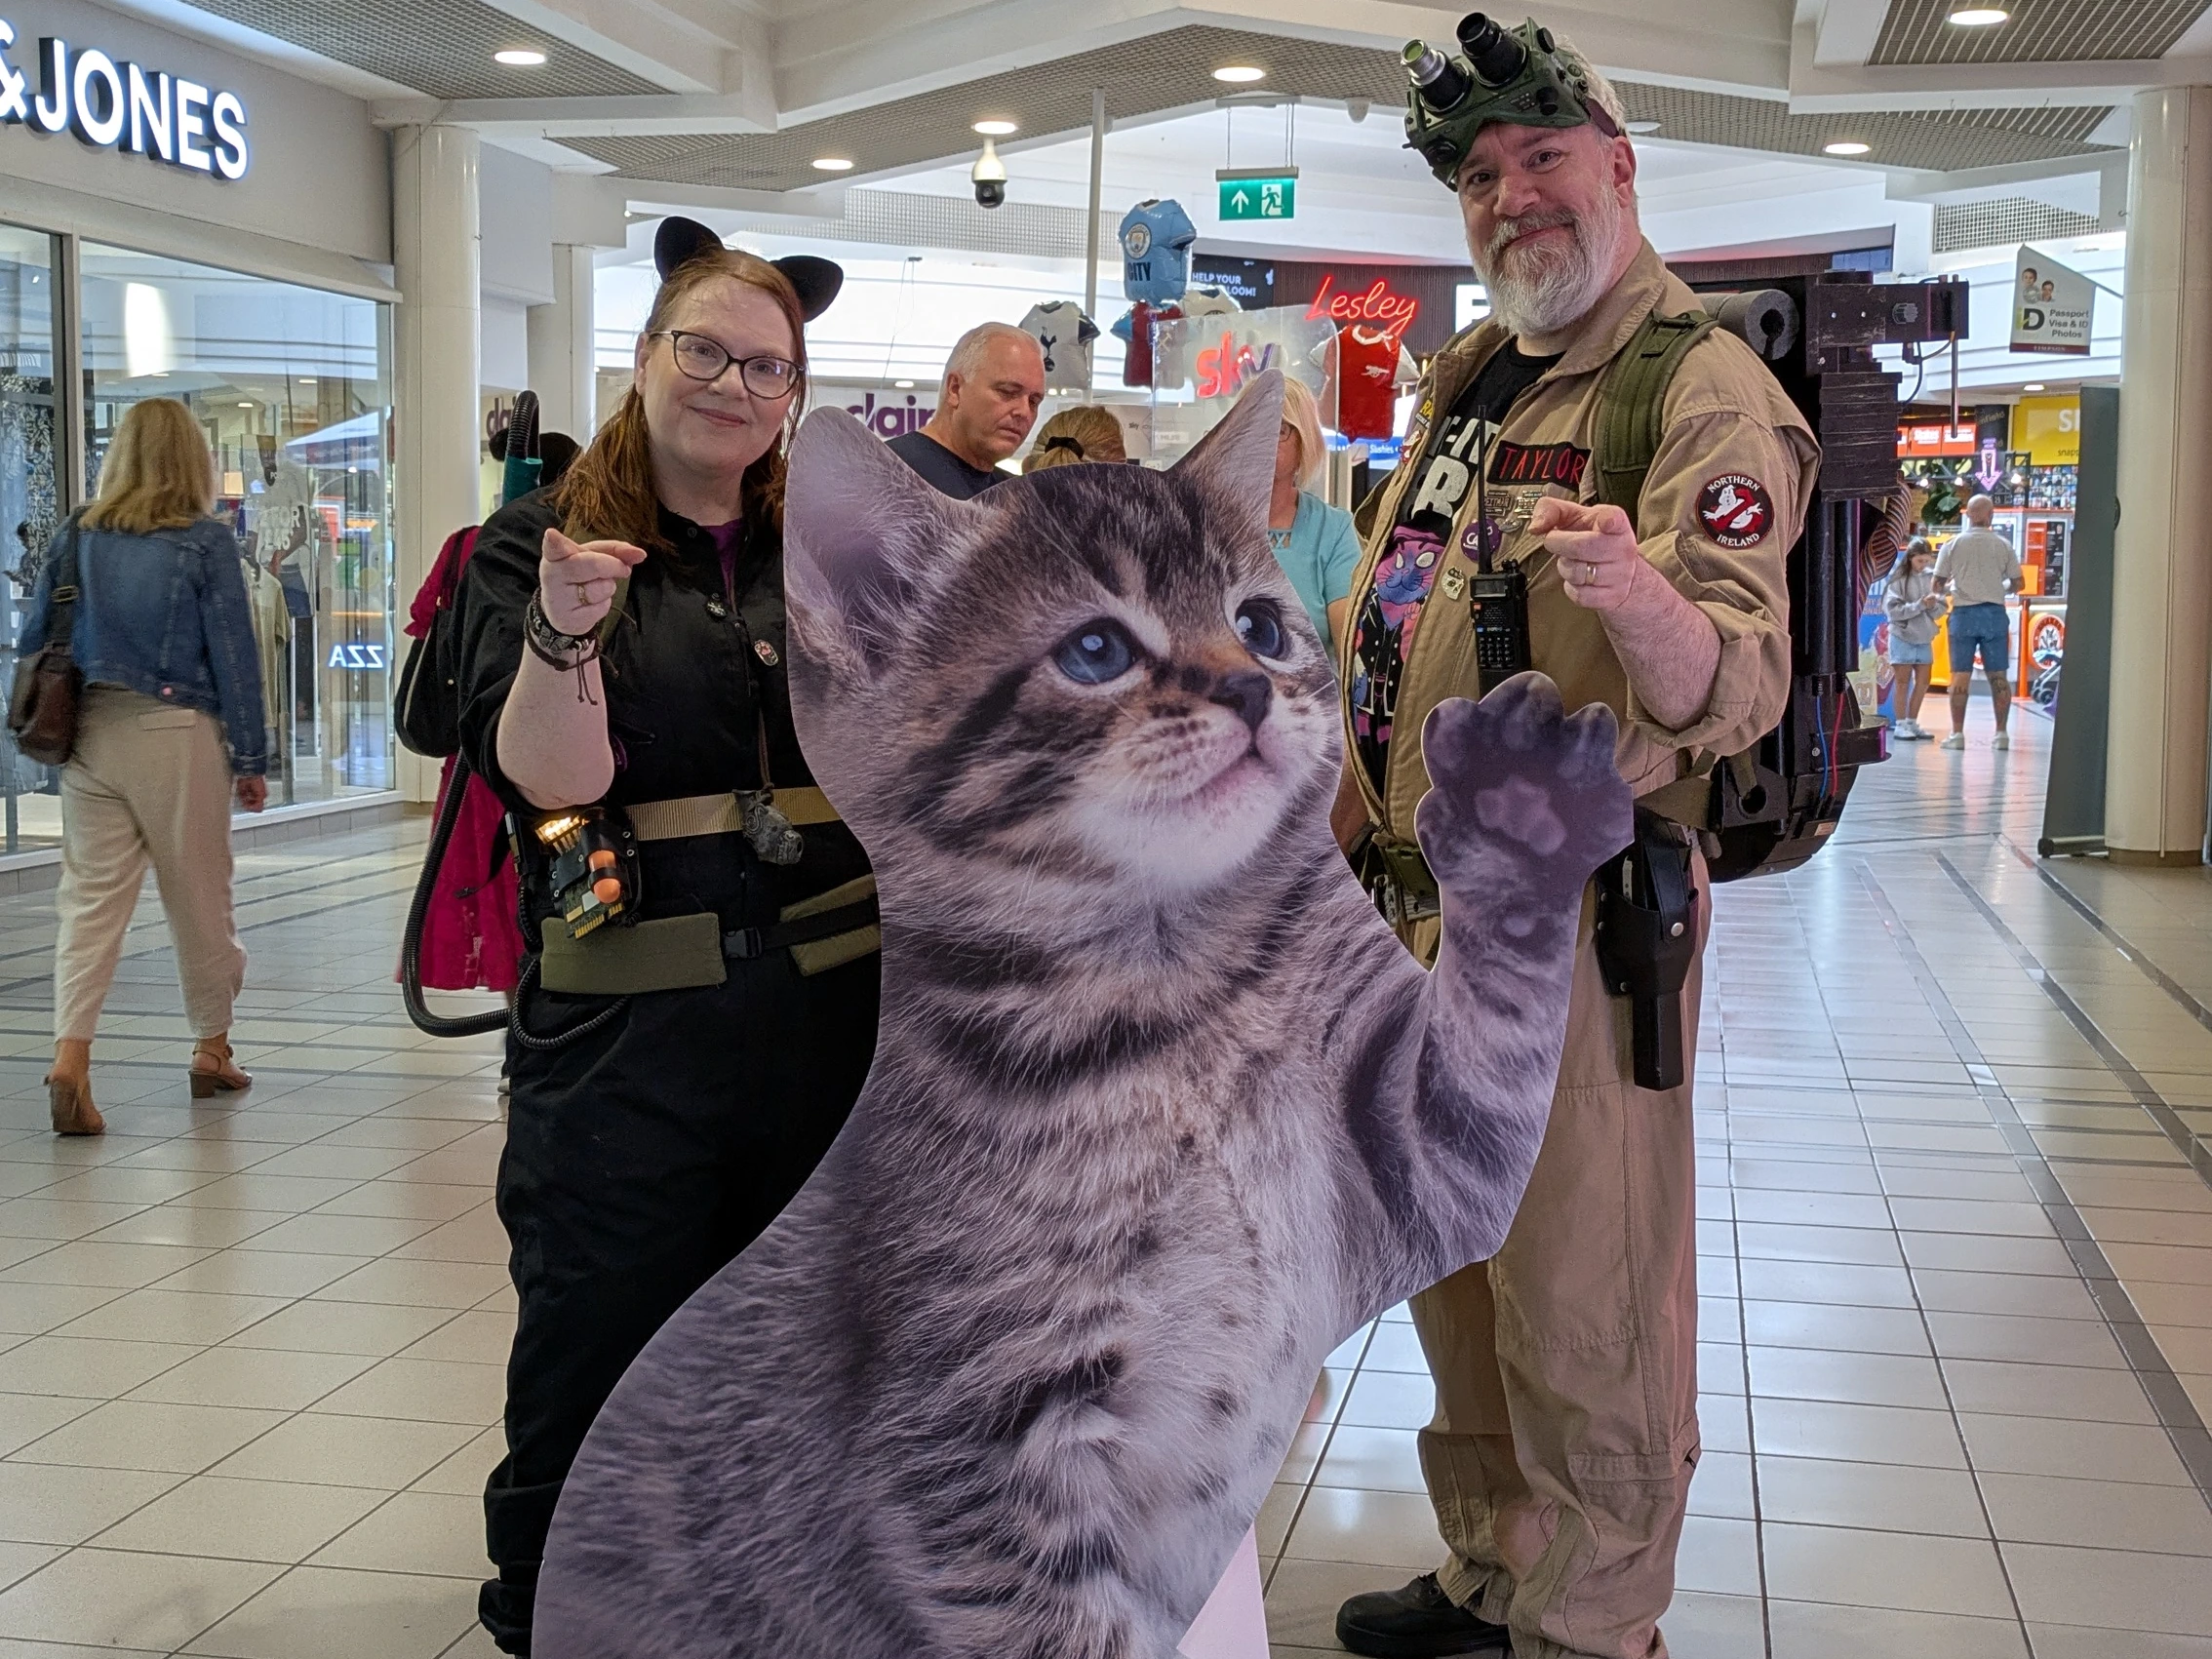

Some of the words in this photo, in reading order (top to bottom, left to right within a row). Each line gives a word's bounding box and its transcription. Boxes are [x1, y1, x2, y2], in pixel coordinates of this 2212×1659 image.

[1127, 262, 1151, 281] CITY
[1192, 272, 1214, 282] HELP
[1216, 274, 1242, 285] YOUR
[1304, 276, 1416, 336] Lesley
[2049, 308, 2089, 318] Passport
[2049, 319, 2068, 328] Visa
[2078, 319, 2089, 329] ID
[2051, 329, 2082, 338] Photos
[1197, 331, 1275, 398] sky
[1499, 448, 1586, 485] TAYLOR
[1707, 475, 1760, 494] NORTHERN
[1717, 533, 1759, 546] IRELAND
